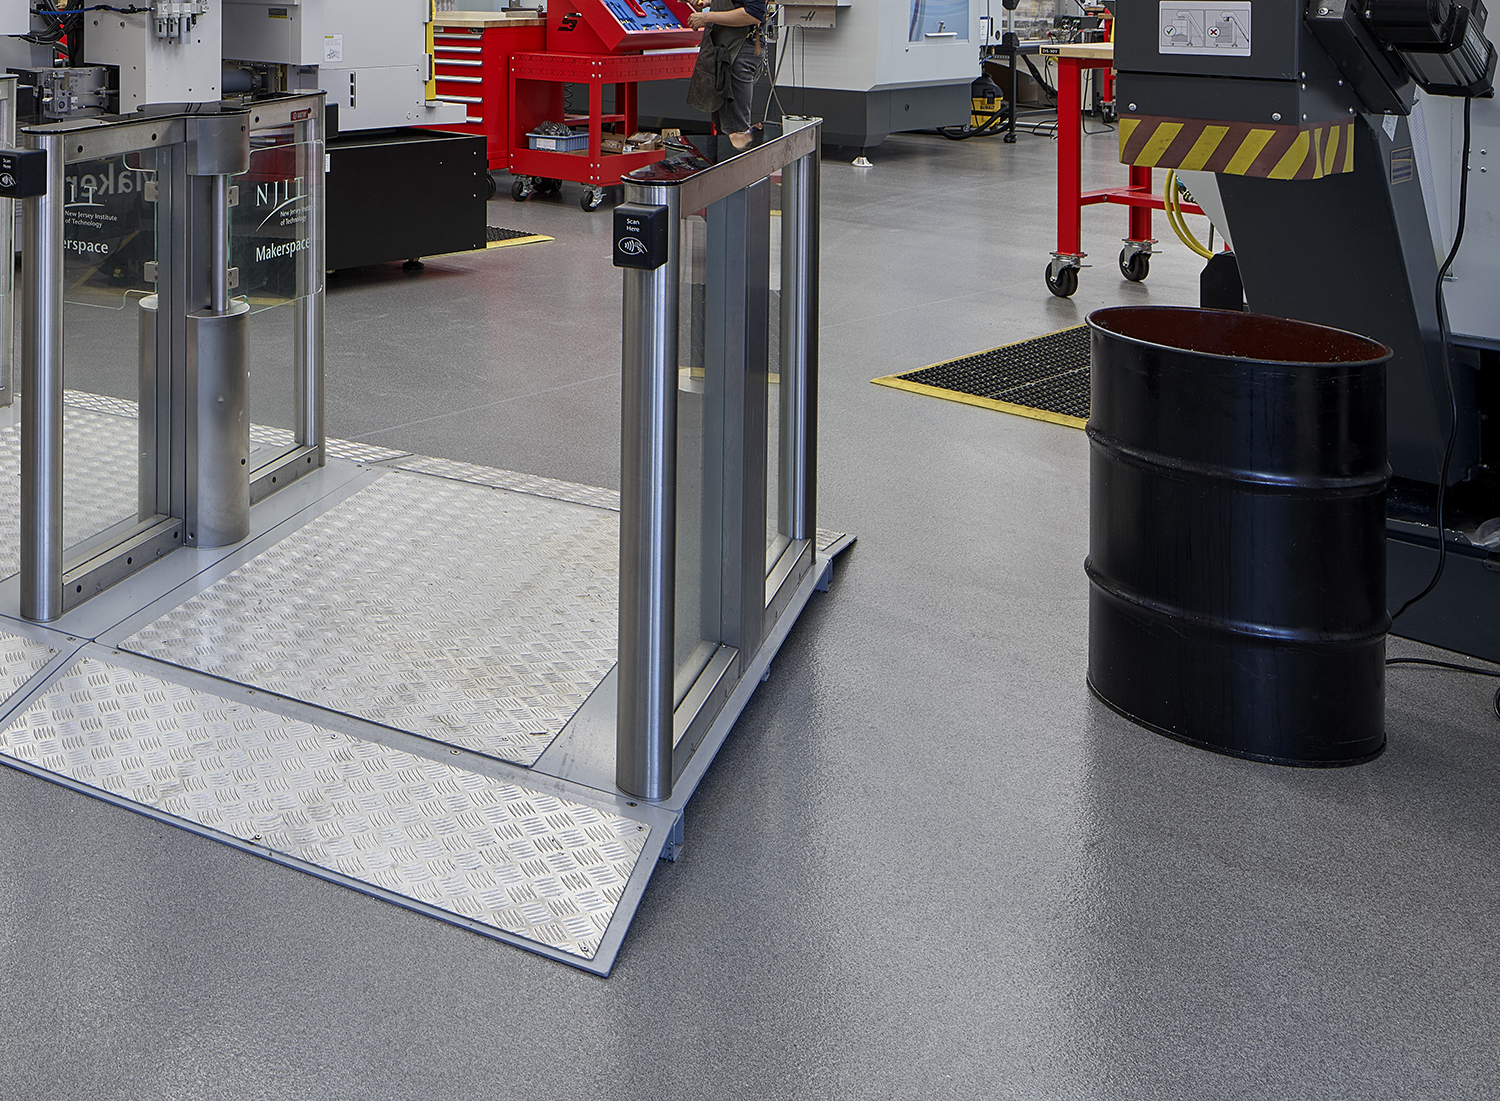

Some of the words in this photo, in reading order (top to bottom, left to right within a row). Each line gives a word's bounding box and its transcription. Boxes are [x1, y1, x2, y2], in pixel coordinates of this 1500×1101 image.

[256, 176, 304, 209] NJIT
[77, 211, 95, 220] Jersey
[94, 213, 118, 222] Institute
[72, 218, 103, 229] Technology
[626, 225, 640, 233] Here
[255, 237, 311, 263] Makerspace
